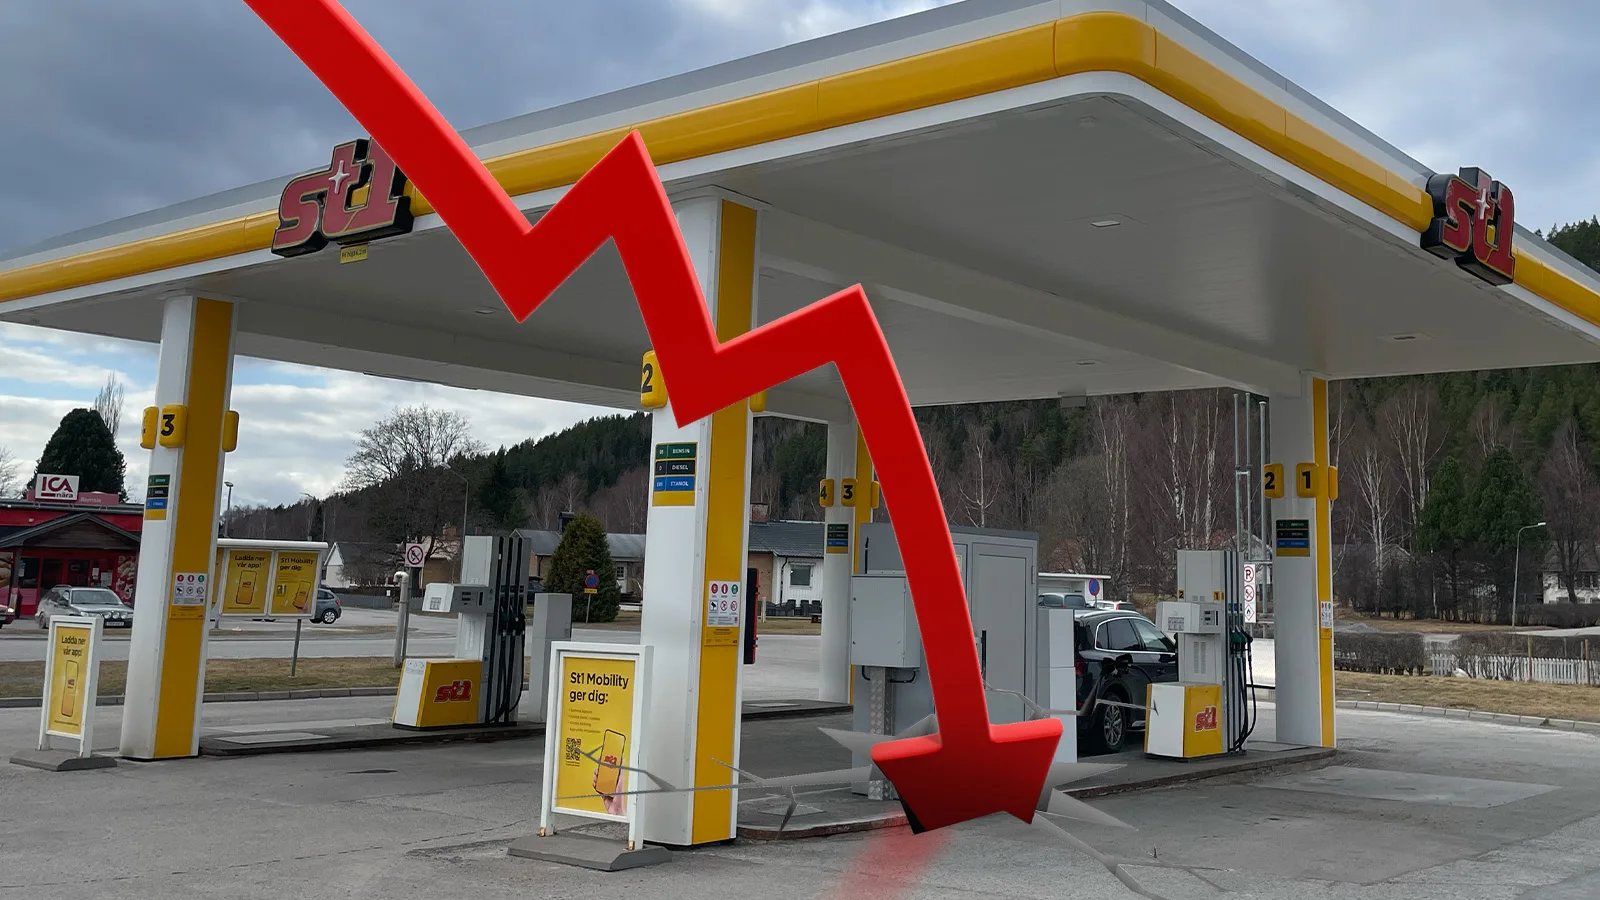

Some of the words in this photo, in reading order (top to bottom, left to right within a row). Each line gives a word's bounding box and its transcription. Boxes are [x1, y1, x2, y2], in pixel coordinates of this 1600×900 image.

[642, 363, 653, 393] 2
[161, 414, 176, 436] 3
[42, 476, 73, 492] ICA
[1264, 472, 1276, 490] 2
[1302, 471, 1310, 489] 1
[820, 485, 827, 500] 4
[843, 485, 853, 500] 3
[62, 636, 77, 644] Ladda
[570, 672, 584, 684] St1
[586, 673, 629, 689] Mobility
[570, 690, 586, 702] ger
[588, 690, 608, 705] dig:
